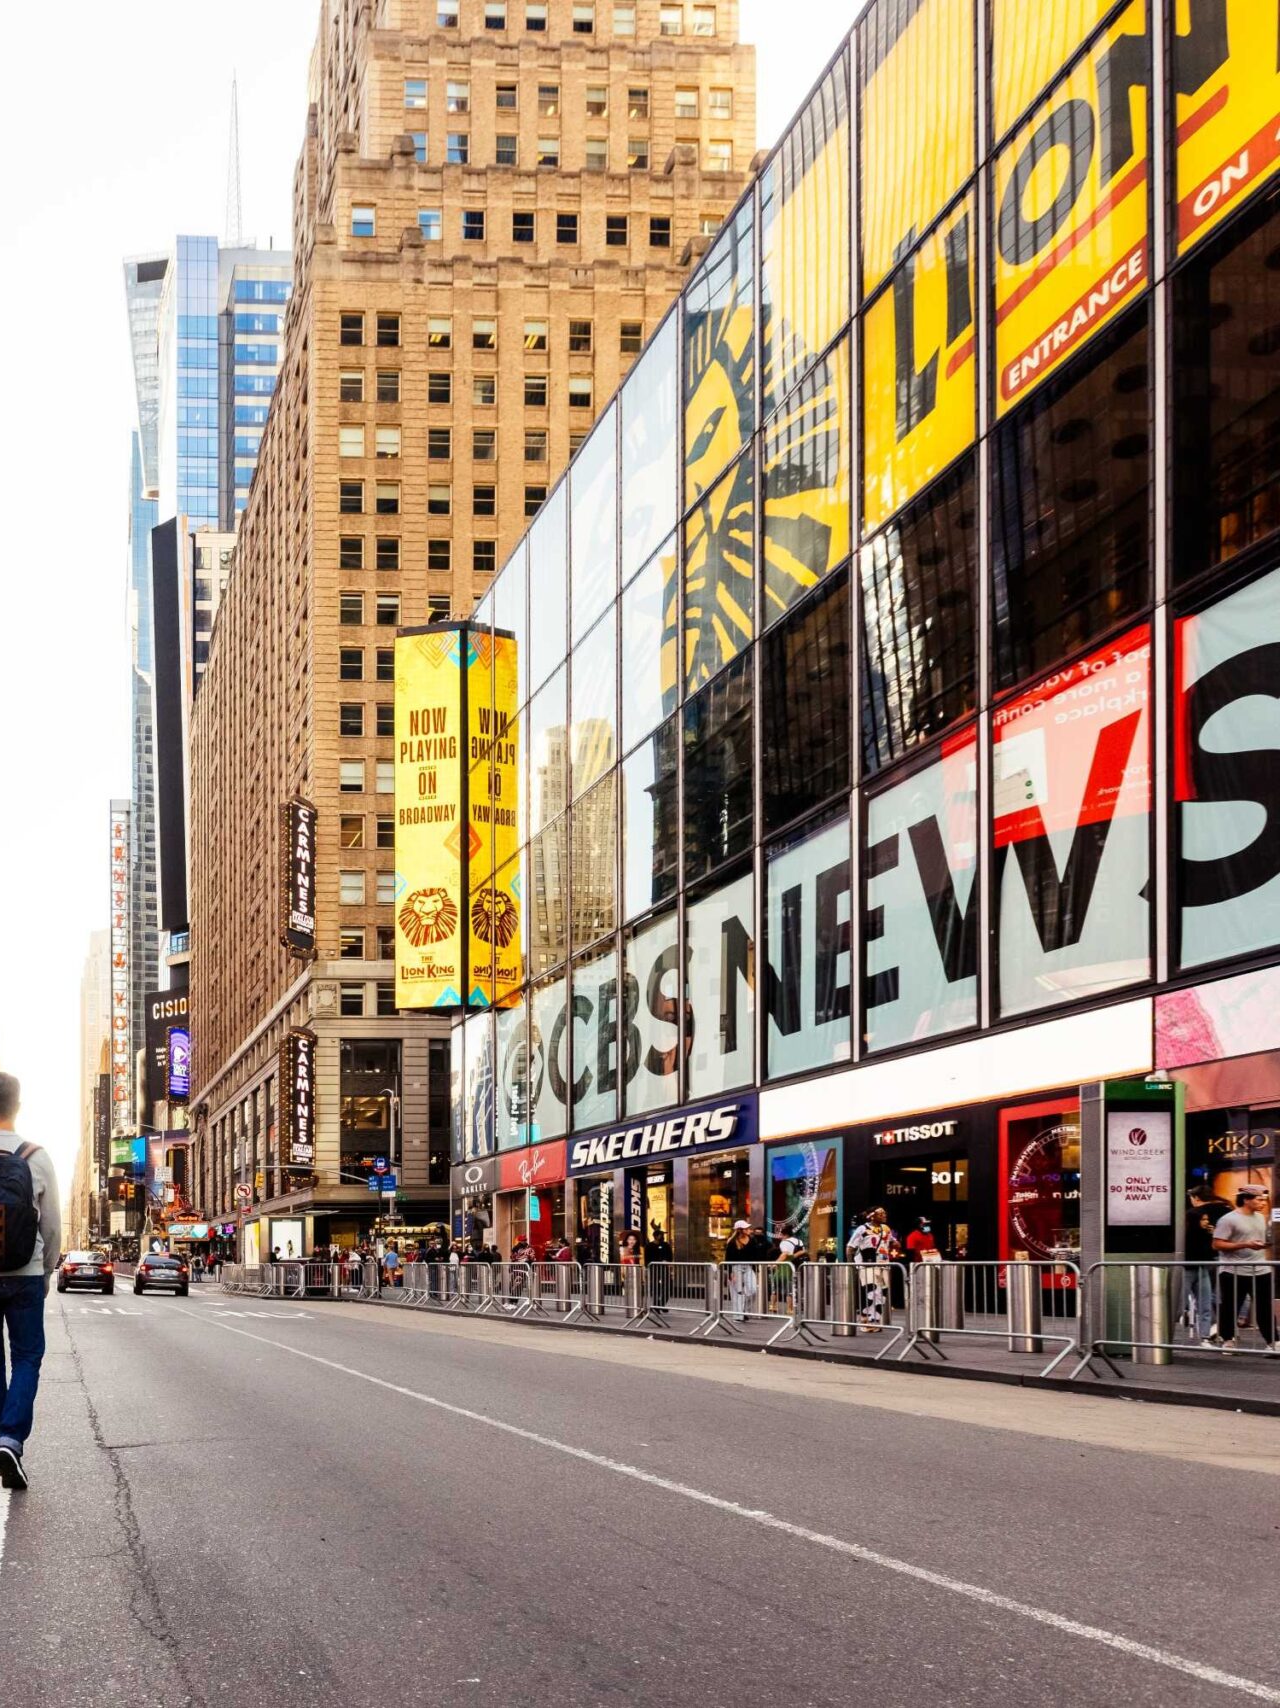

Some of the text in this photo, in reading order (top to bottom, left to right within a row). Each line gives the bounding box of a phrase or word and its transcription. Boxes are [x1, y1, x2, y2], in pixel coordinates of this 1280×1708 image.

[1008, 151, 1250, 391] ENTRANCE ON
[409, 707, 447, 737] NOW
[400, 736, 457, 764] PLAYING
[418, 771, 437, 795] ON
[399, 804, 456, 825] BROADWAY
[549, 643, 1280, 1107] CBS NEWS
[570, 1103, 740, 1169] SKECHERS
[1208, 1134, 1270, 1154] KIKO
[1110, 1185, 1168, 1193] 90 MINUTES
[1125, 1177, 1152, 1185] ONLY
[1124, 1193, 1153, 1201] AWAY
